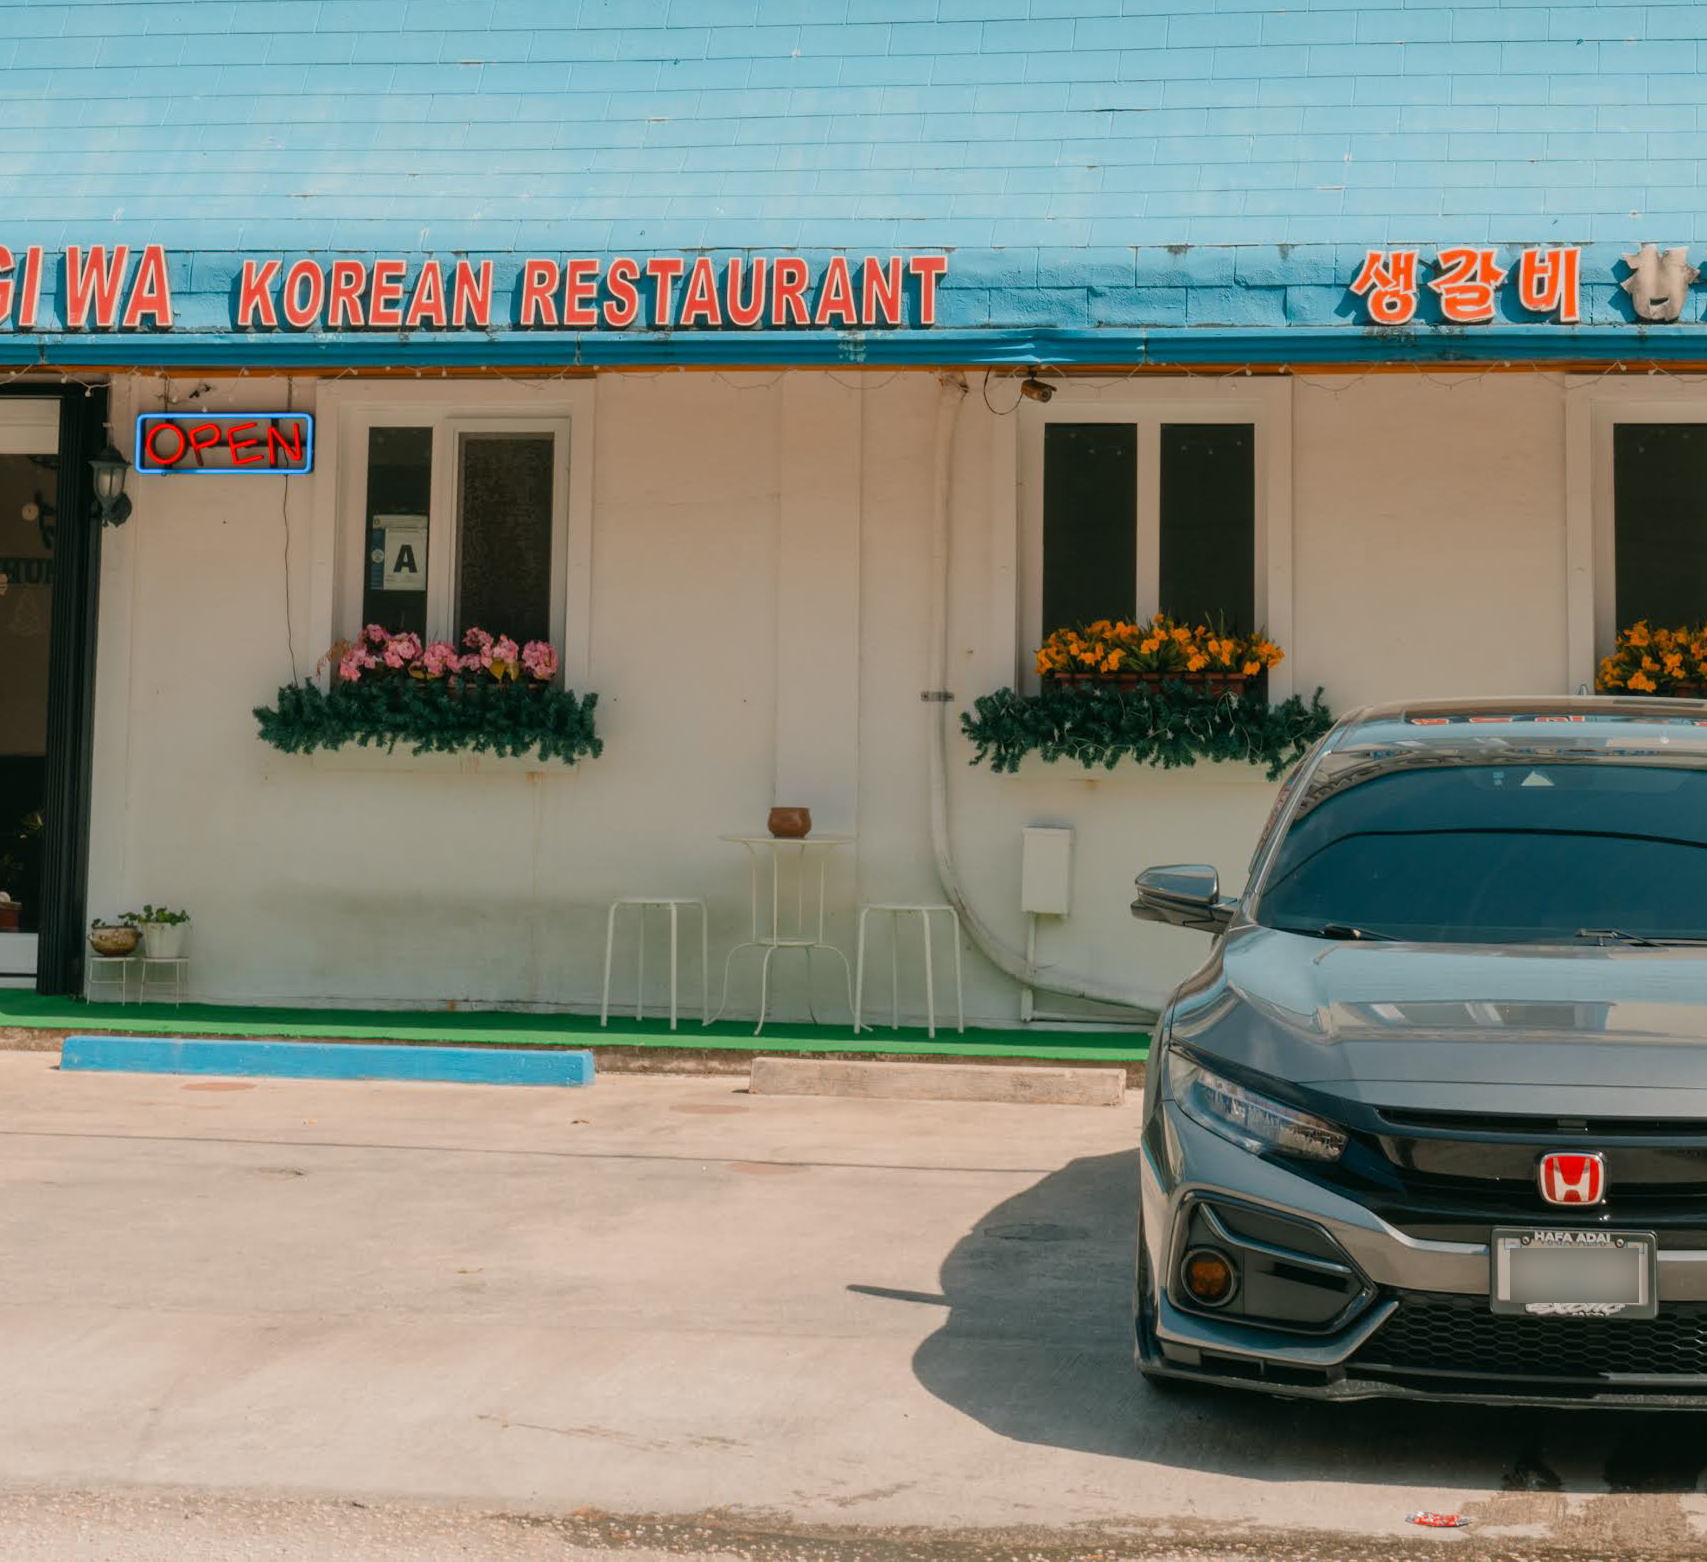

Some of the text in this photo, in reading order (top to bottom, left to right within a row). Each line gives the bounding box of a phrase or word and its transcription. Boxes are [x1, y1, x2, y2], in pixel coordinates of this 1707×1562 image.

[63, 244, 173, 329] WA
[236, 254, 949, 327] KOREAN RESTAURANT
[1349, 245, 1583, 325] 생갈비
[146, 422, 303, 466] OPEN
[394, 544, 418, 573] A
[1534, 1231, 1573, 1243] HAFA
